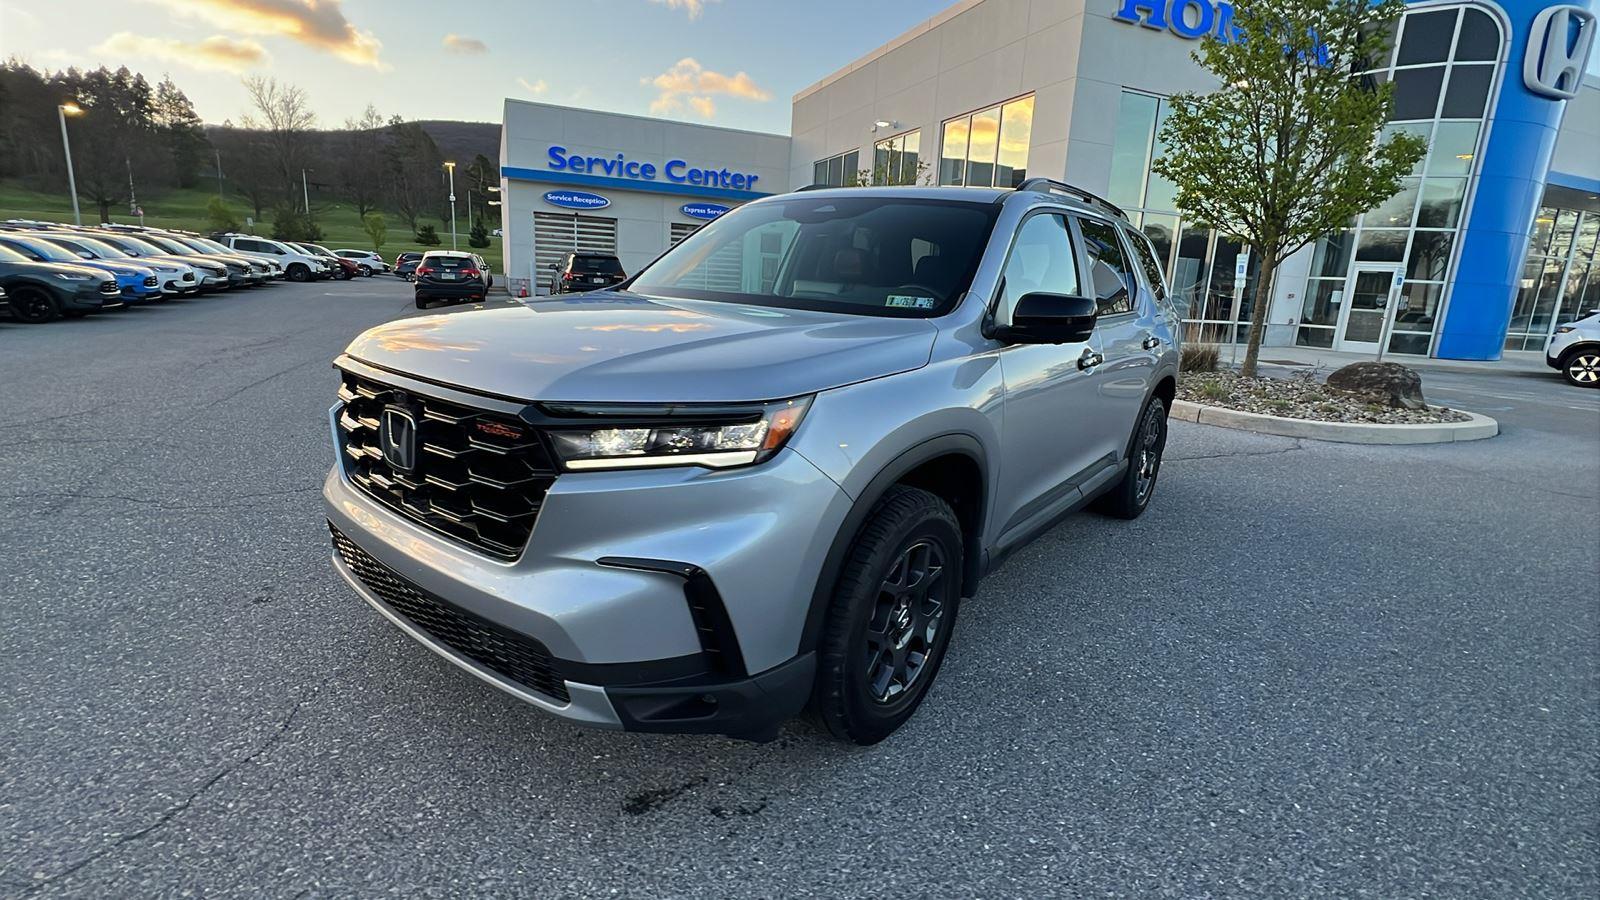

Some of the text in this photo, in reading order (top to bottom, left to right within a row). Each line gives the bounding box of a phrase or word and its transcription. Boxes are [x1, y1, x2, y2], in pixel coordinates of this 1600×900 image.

[548, 146, 759, 190] Service Center
[547, 193, 606, 205] Service Reception
[683, 206, 706, 214] Express
